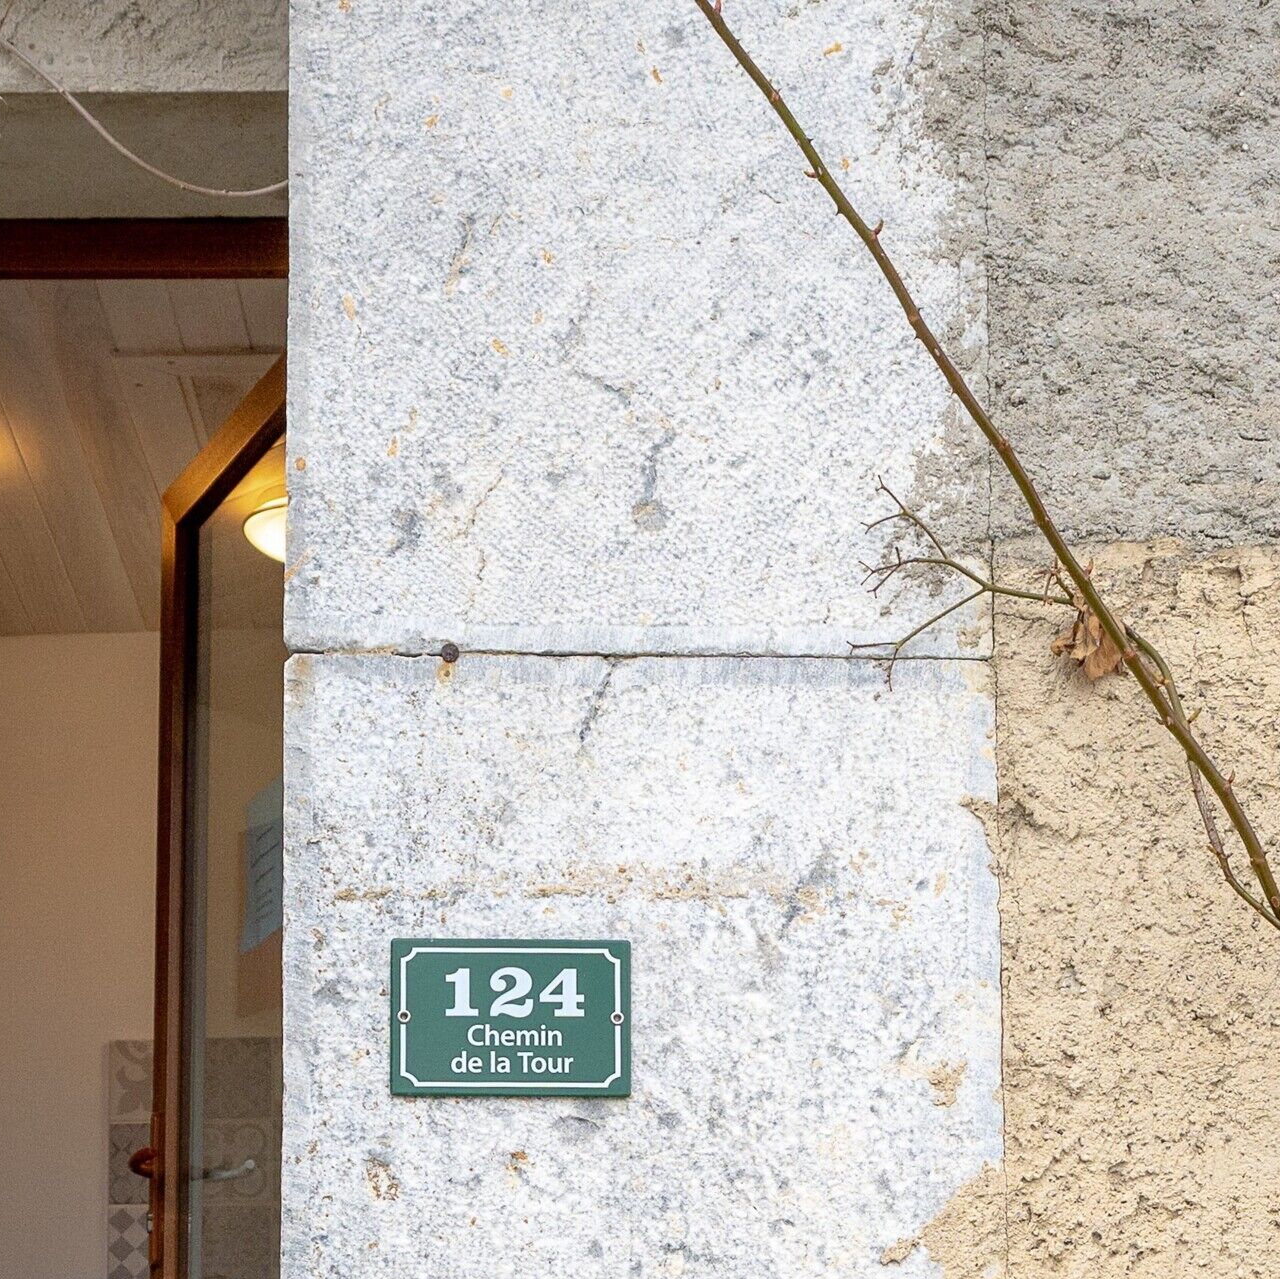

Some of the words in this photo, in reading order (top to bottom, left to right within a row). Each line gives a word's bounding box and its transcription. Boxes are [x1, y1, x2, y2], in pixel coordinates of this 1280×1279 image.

[445, 966, 585, 1018] 124
[467, 1024, 563, 1047] Chemin
[450, 1051, 483, 1074] de
[490, 1051, 511, 1074] la
[517, 1051, 574, 1074] Tour
